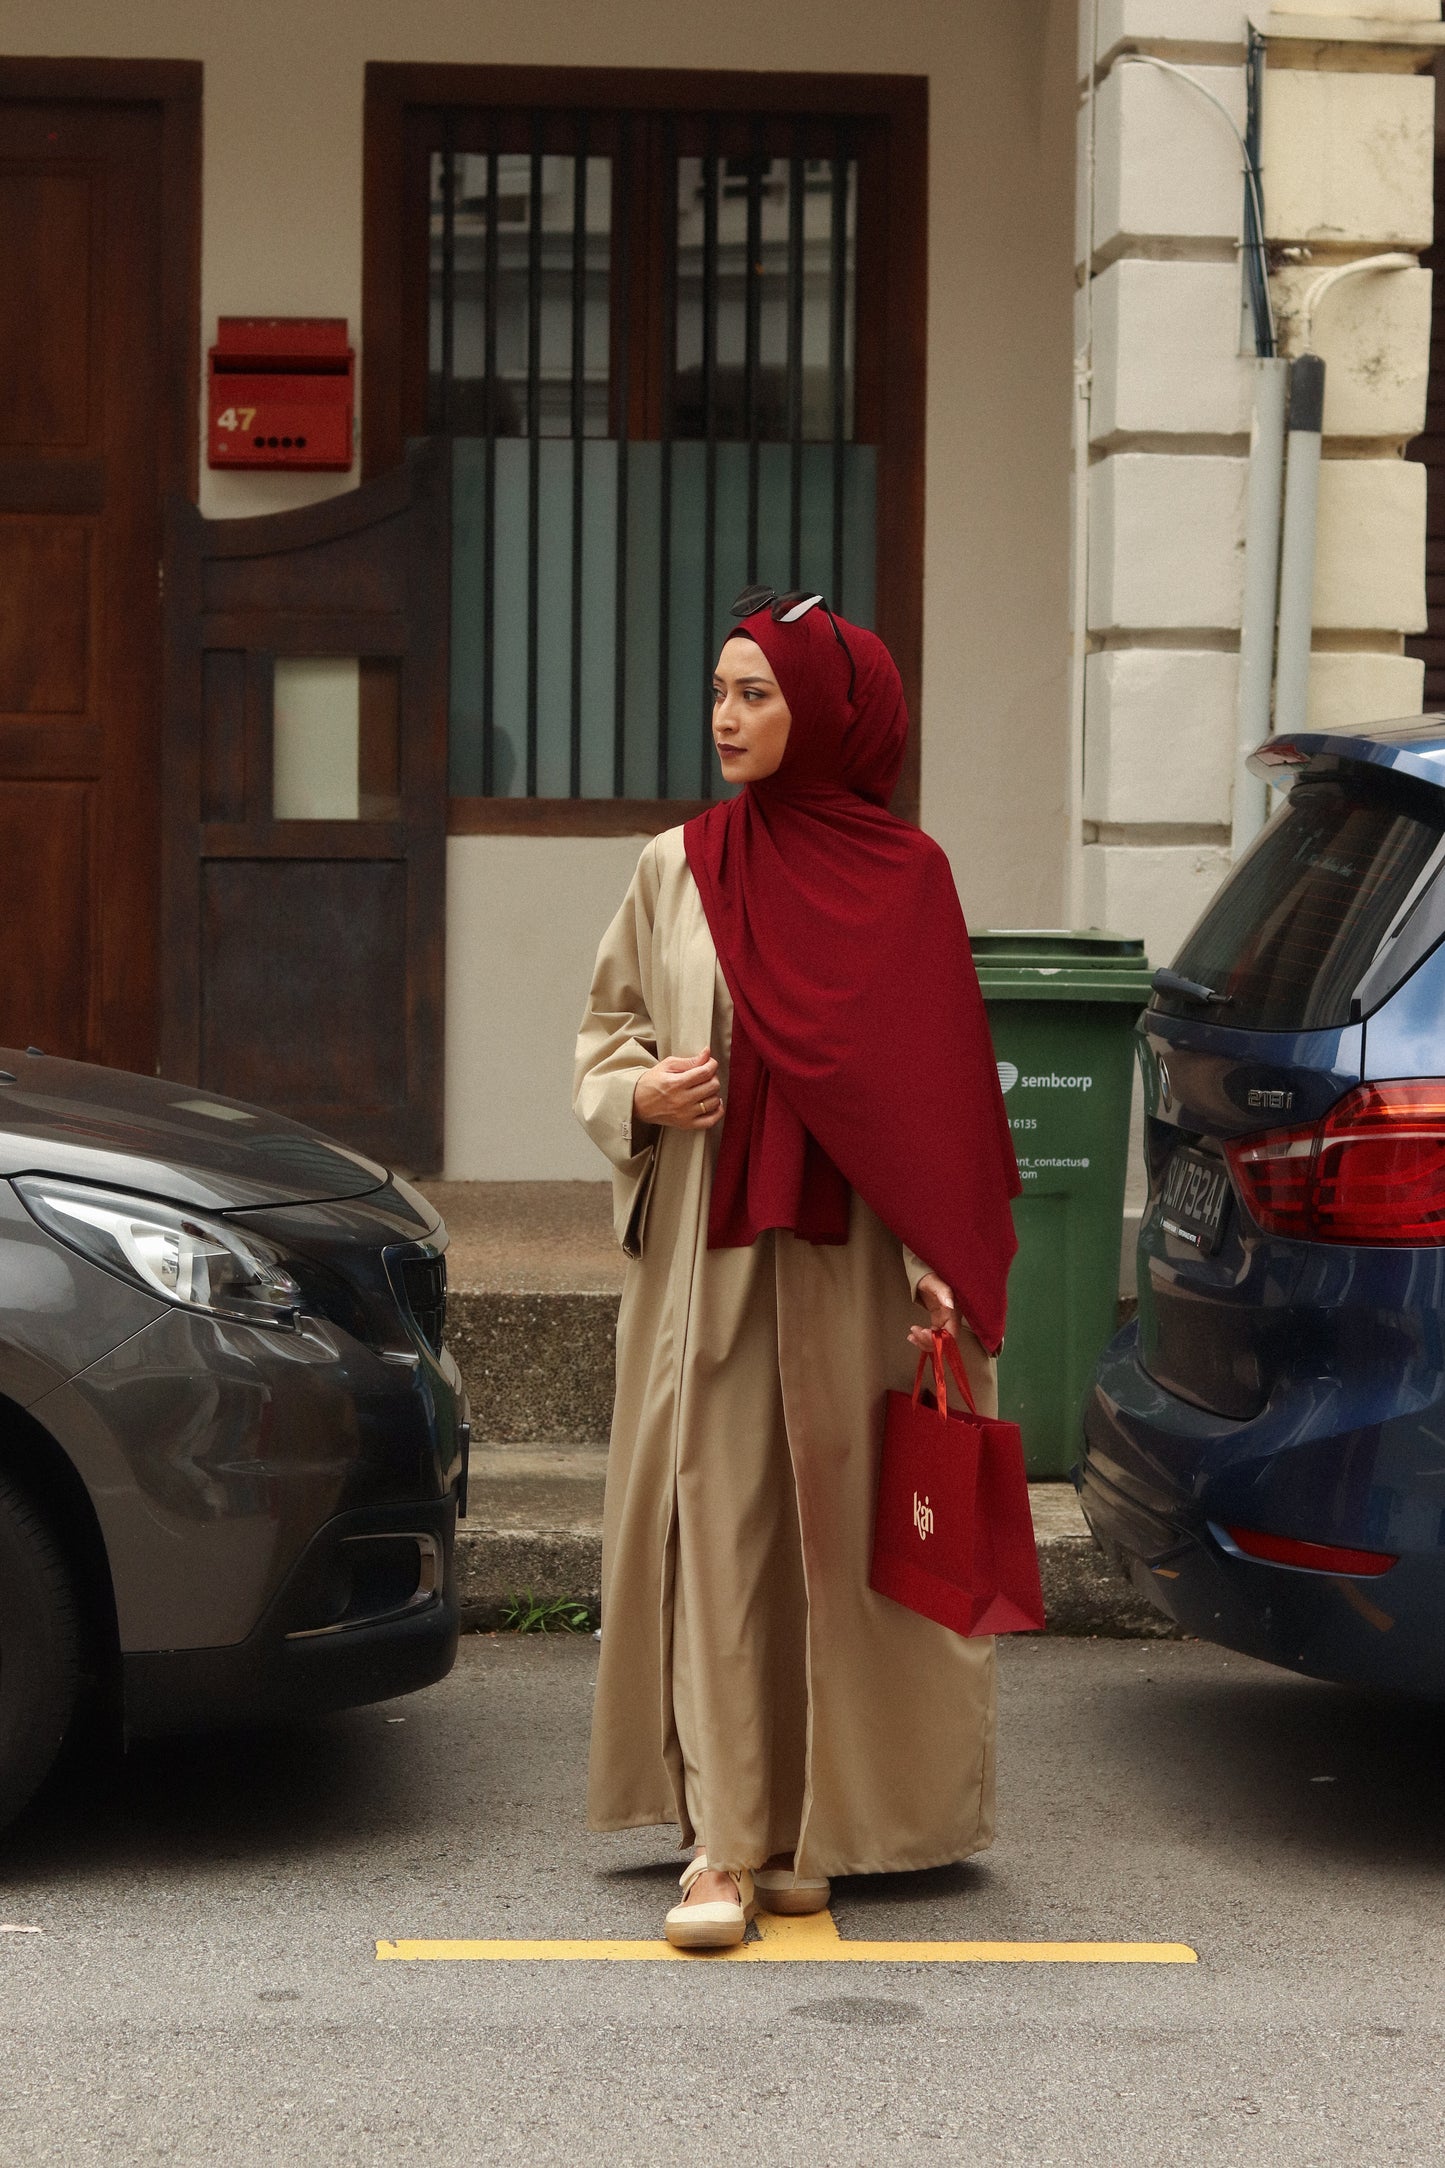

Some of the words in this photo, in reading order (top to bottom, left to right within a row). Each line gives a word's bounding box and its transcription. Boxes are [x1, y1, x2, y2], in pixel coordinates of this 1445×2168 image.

[217, 407, 257, 432] 47
[1021, 1072, 1092, 1092] sembcorp
[1013, 1119, 1037, 1129] 6135
[1019, 1171, 1038, 1179] om
